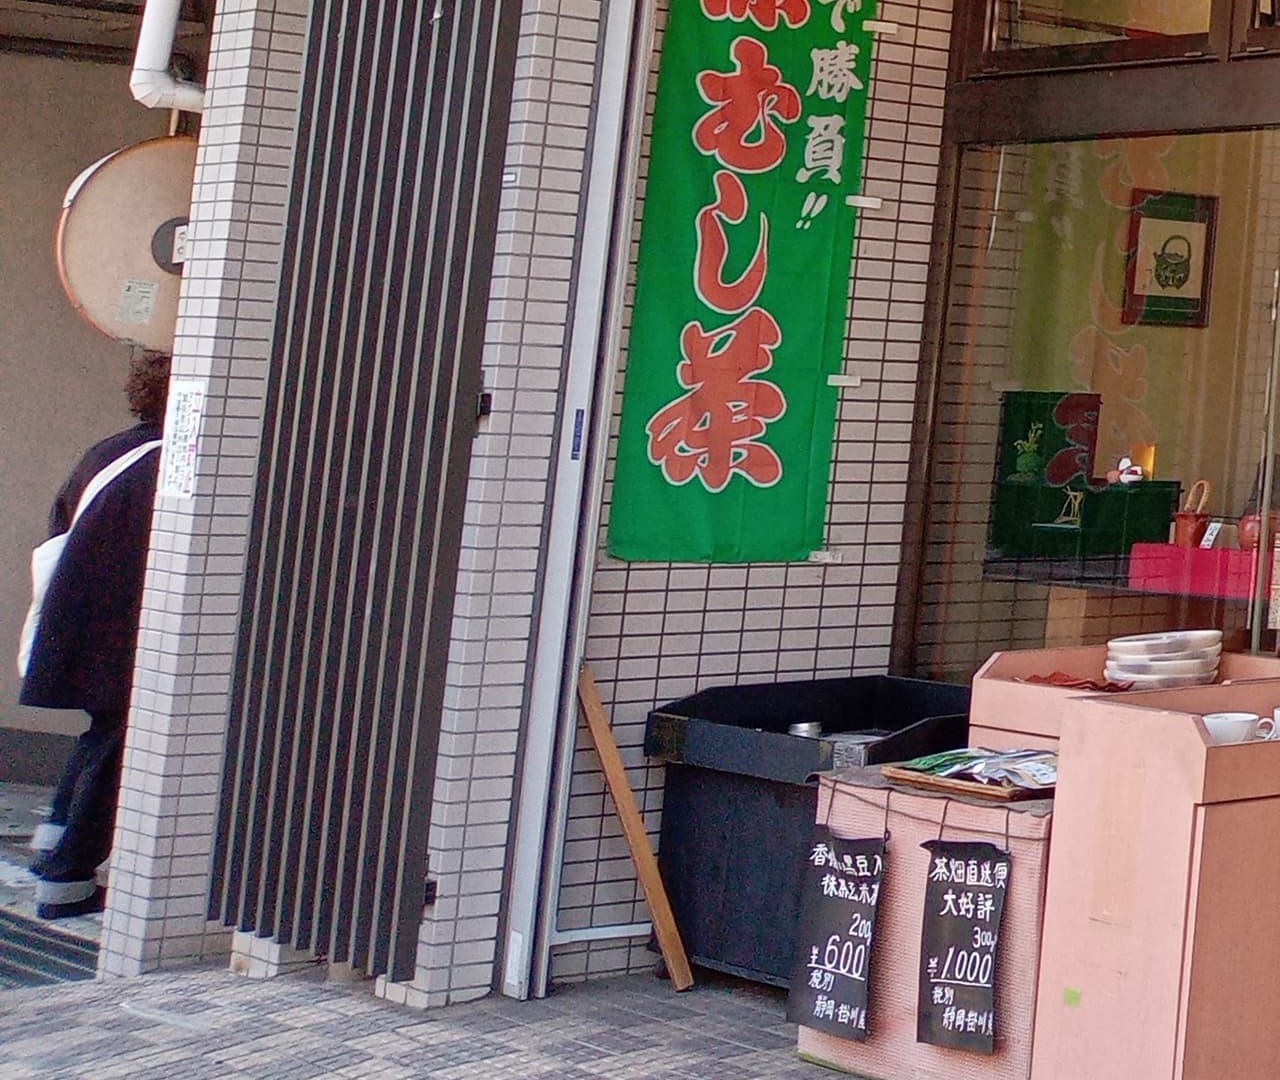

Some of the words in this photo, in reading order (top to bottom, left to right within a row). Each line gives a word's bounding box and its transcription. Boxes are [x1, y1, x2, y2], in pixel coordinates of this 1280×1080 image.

[929, 856, 1008, 889] 茶畑直送便
[939, 888, 995, 923] 大好評
